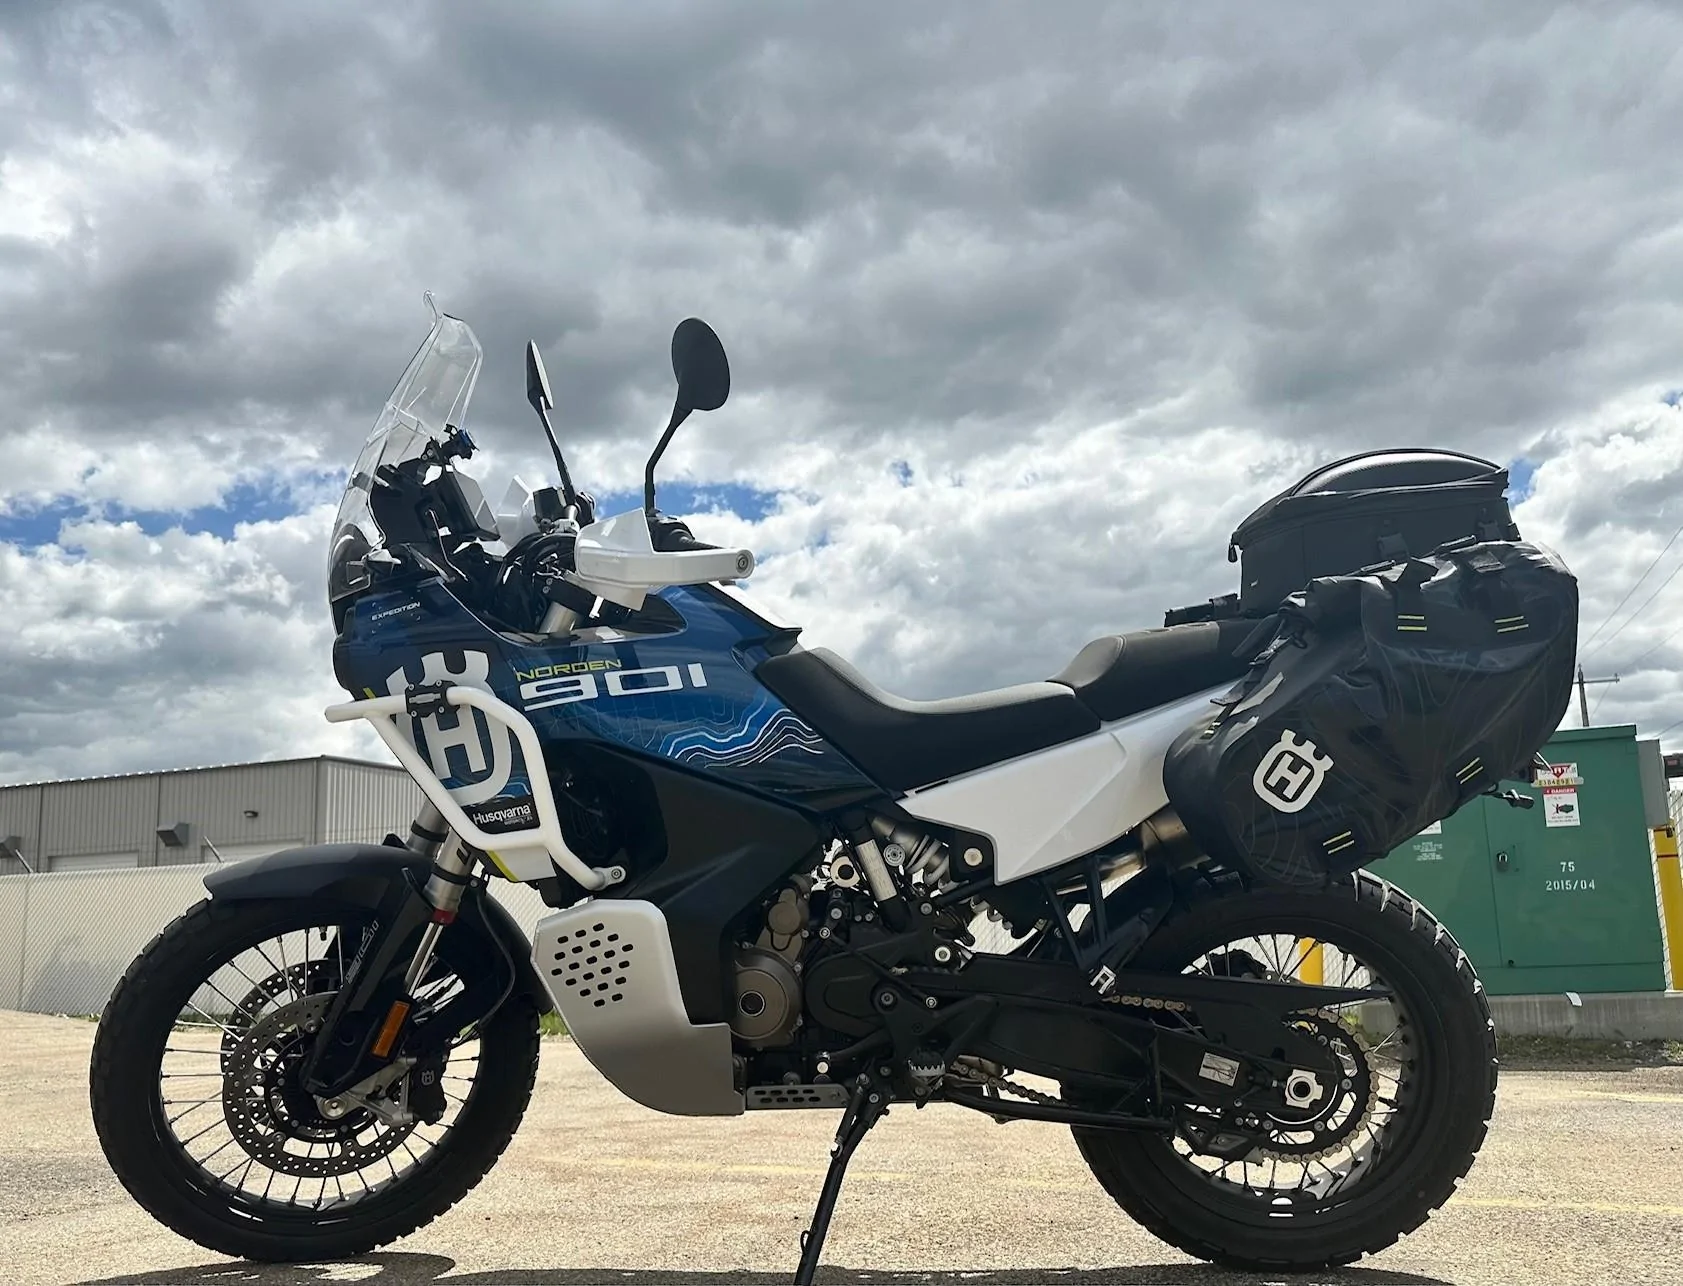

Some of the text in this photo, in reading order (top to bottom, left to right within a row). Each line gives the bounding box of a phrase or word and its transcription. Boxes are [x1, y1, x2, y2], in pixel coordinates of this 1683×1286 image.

[371, 601, 421, 621] EXPEDITION
[516, 659, 622, 682] NORDEN
[519, 662, 708, 712] 901
[472, 804, 531, 825] Husqvarna
[1560, 861, 1575, 873] 75
[1545, 879, 1595, 891] 2015/04
